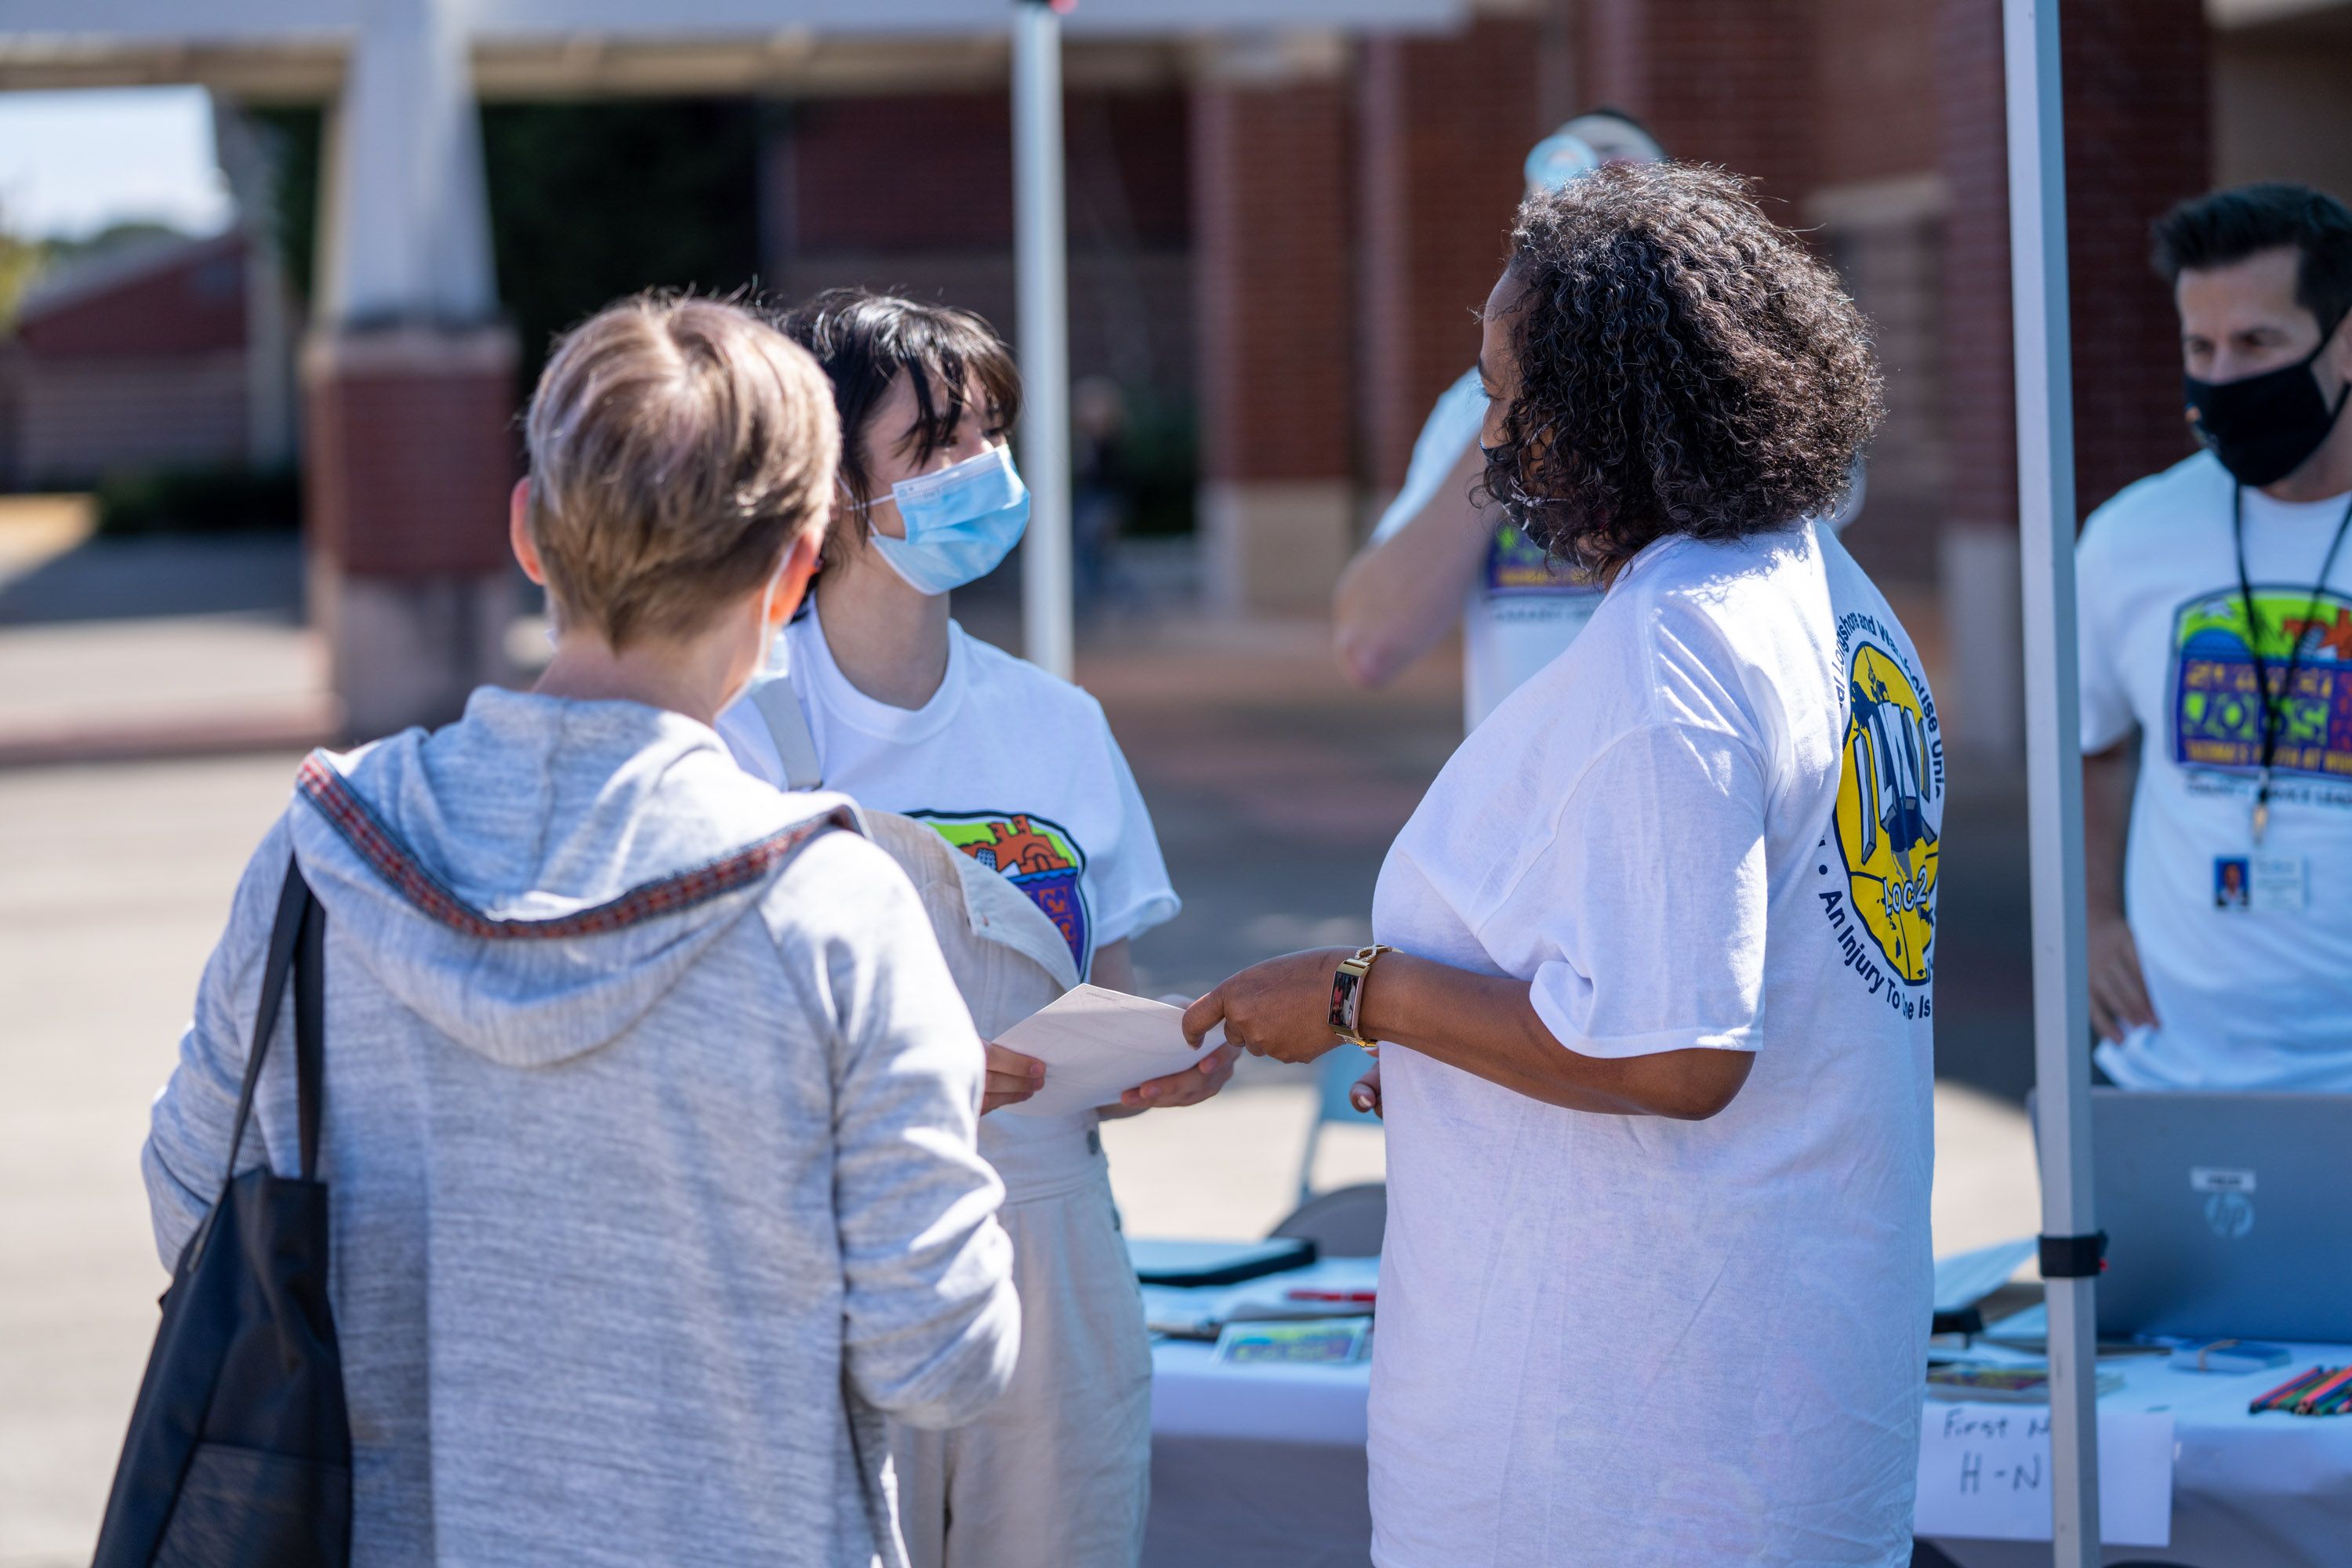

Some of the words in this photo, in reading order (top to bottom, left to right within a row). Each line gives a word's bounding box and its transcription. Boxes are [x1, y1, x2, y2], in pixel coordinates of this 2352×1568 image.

[1831, 612, 1860, 677] Longshore
[1858, 612, 1878, 637] and
[1876, 619, 1938, 733] Warhouse
[1882, 876, 1914, 919] LOC
[1818, 890, 1846, 930] An
[1837, 924, 1885, 995] Injury
[1886, 976, 1900, 1010] To
[1918, 994, 1931, 1019] Is
[1943, 1407, 2009, 1439] First
[2027, 1417, 2053, 1439] N
